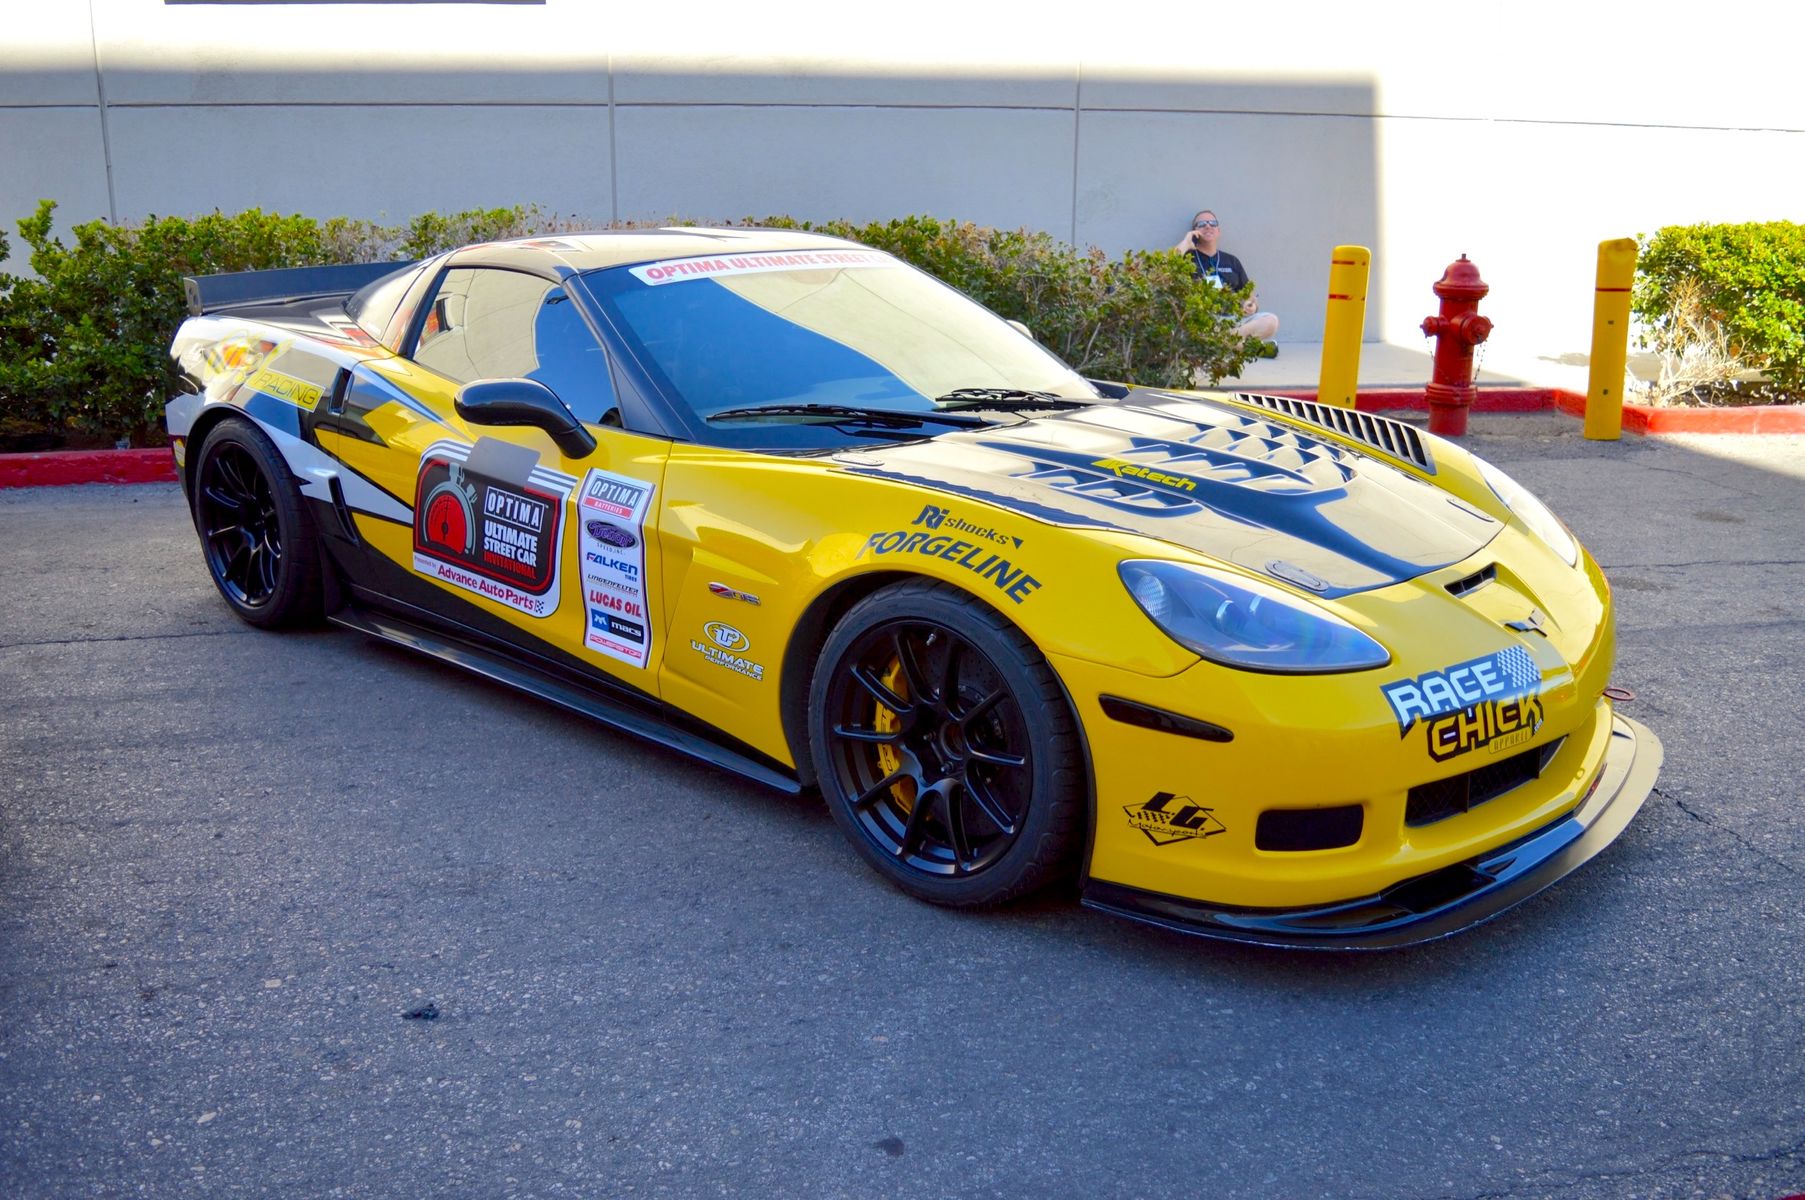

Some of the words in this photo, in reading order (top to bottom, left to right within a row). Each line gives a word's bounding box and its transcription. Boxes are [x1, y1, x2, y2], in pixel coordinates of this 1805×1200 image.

[646, 259, 730, 280] OPTIMA
[729, 254, 815, 270] ULTIMATE
[255, 373, 319, 406] RACING
[487, 492, 540, 527] OPTIMA
[590, 481, 640, 508] OPTIMA
[594, 500, 623, 514] BATTERIES
[484, 520, 538, 552] ULTIMATE
[944, 516, 1010, 545] shocks
[483, 536, 517, 560] STREET
[516, 548, 537, 567] CAR
[586, 551, 638, 576] FALKEN
[855, 531, 1043, 605] FORGELINE
[437, 564, 478, 589] Advance
[479, 579, 505, 599] Auto
[505, 588, 534, 610] Parts
[587, 573, 639, 595] LINGENFELTER
[590, 589, 622, 612] LUCAS
[624, 603, 642, 618] OIL
[690, 639, 764, 675] ULTIMATE
[1387, 660, 1505, 728] RACE
[1430, 687, 1543, 757] CHICK
